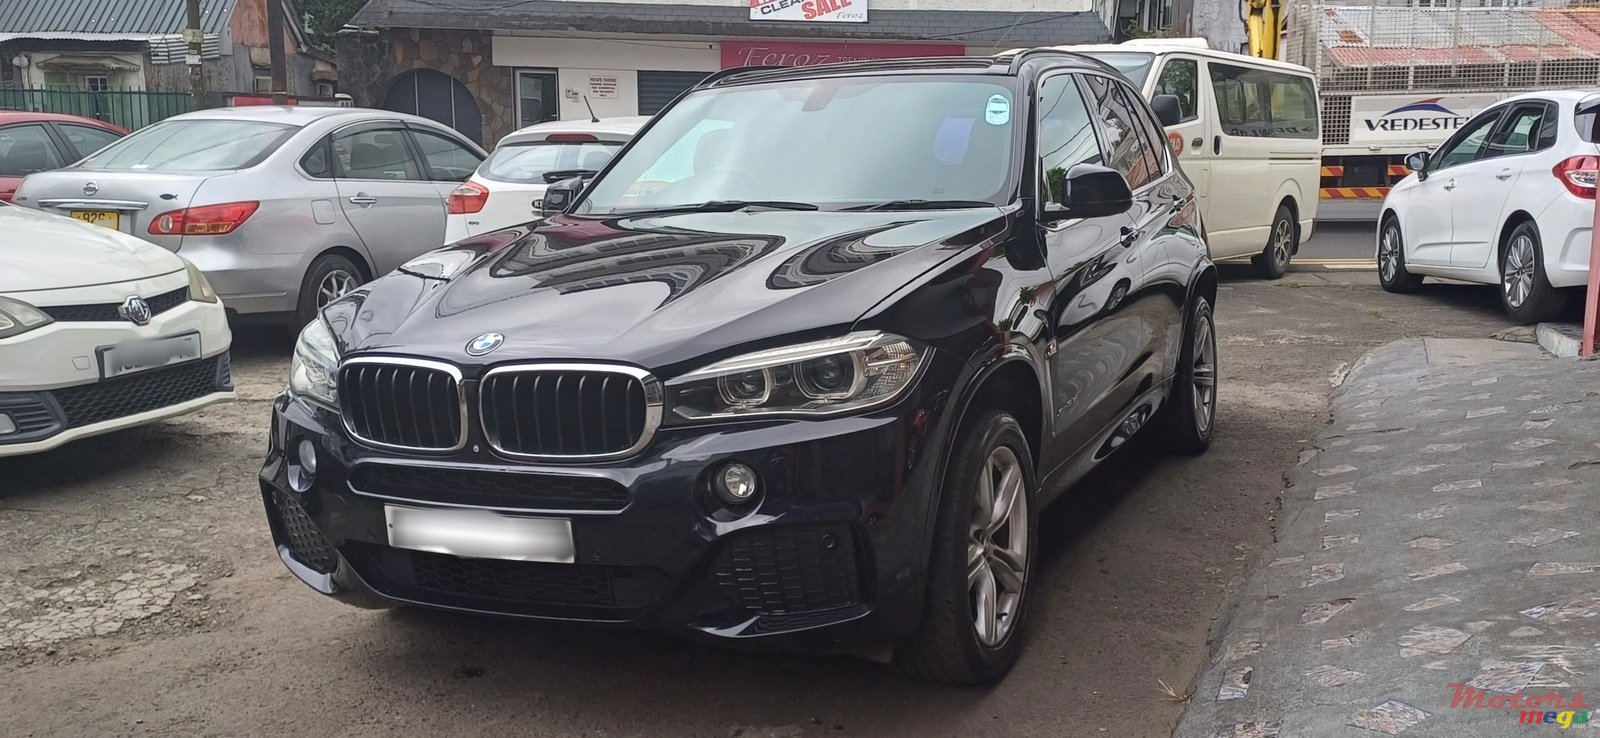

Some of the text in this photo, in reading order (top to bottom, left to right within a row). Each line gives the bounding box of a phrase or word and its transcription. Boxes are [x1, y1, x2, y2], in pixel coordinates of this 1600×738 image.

[760, 0, 804, 15] CLEA
[836, 11, 864, 19] Feroz
[738, 46, 831, 67] Feroz
